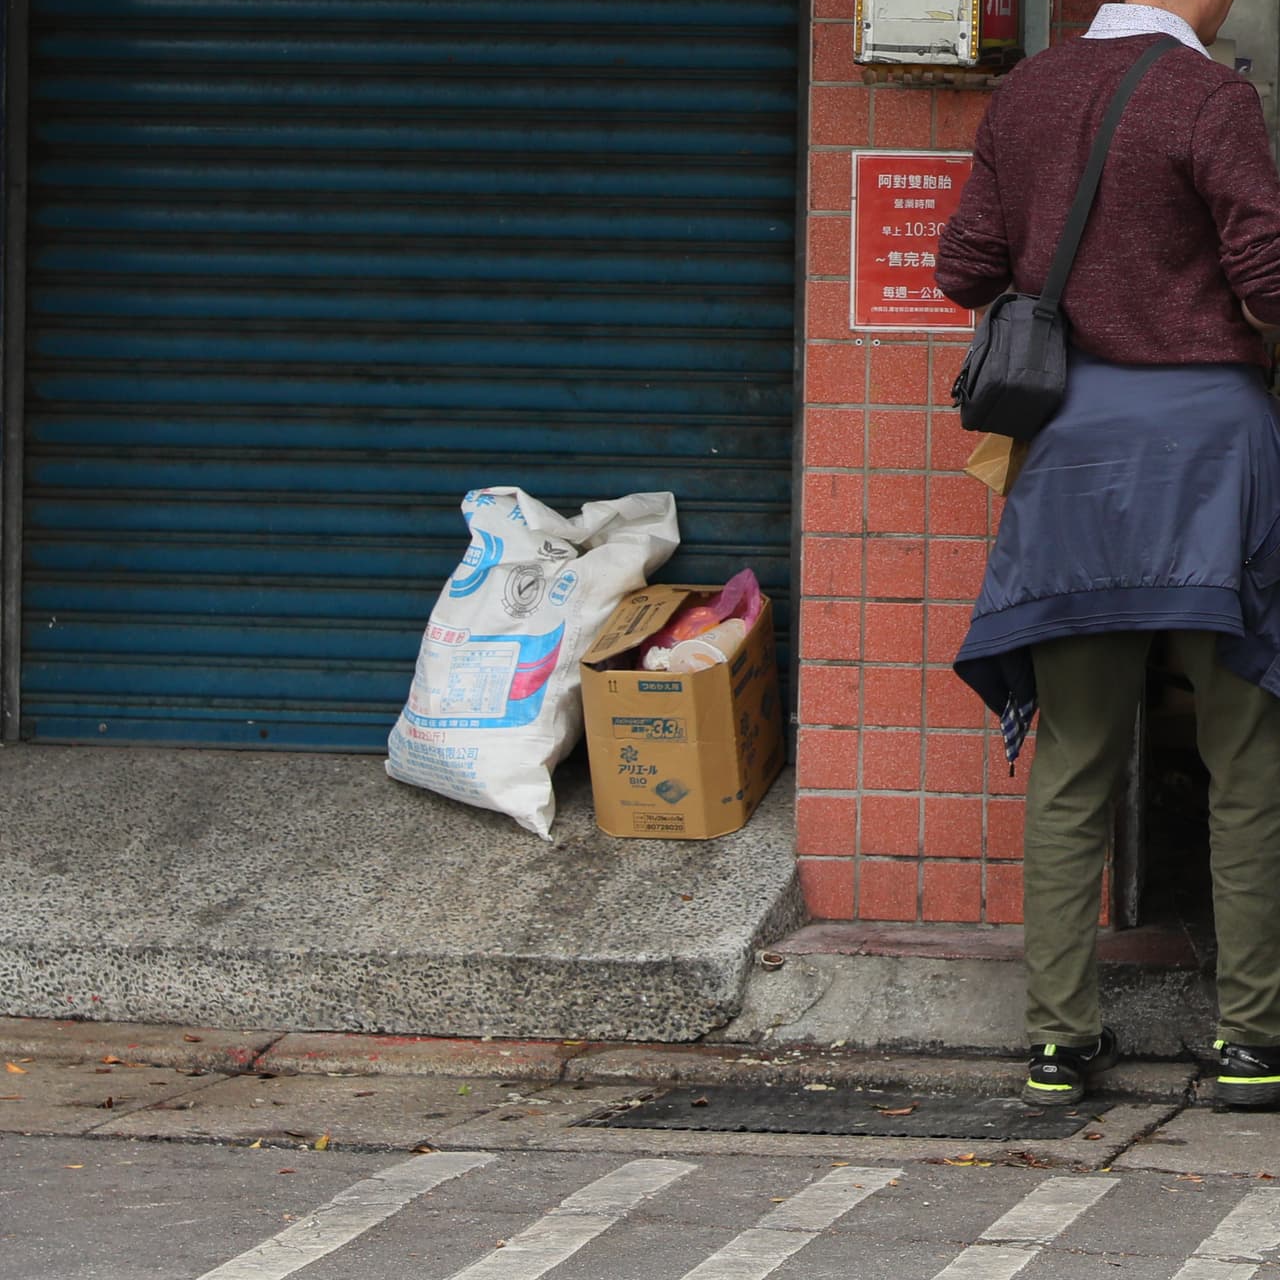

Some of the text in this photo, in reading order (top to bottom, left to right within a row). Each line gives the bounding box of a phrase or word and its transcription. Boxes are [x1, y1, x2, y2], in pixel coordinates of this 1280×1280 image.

[878, 174, 953, 190] 阿對雙胞胎
[894, 198, 936, 209] 營業時間
[882, 224, 902, 236] 早上
[618, 764, 659, 776] アリエール
[629, 777, 648, 786] BIO
